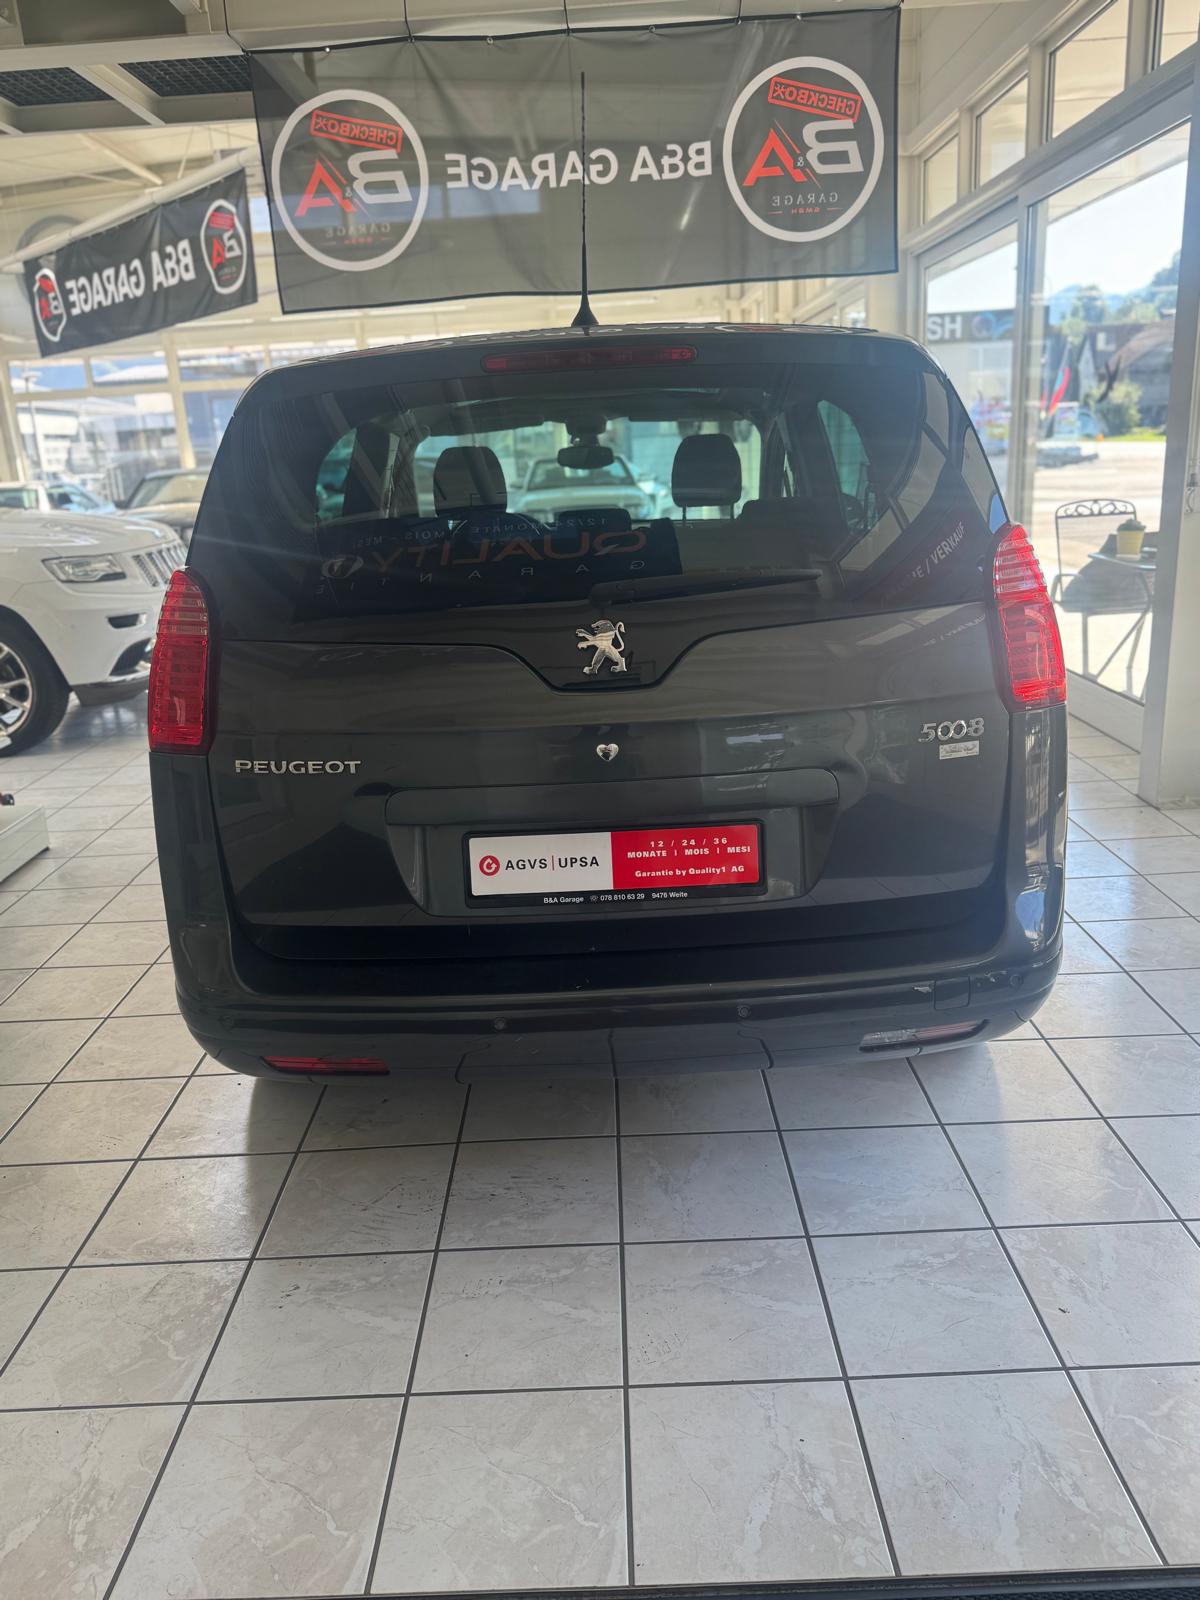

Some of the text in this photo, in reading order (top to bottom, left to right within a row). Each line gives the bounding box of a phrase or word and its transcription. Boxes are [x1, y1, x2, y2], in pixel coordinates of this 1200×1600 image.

[918, 717, 985, 742] 5008
[235, 759, 361, 775] PEUGEOT
[650, 840, 664, 848] 12
[682, 838, 696, 846] 24
[713, 837, 727, 845] 36
[627, 850, 667, 858] MONATE
[685, 847, 709, 856] MOIS
[727, 846, 751, 854] MESI
[505, 856, 599, 871] AGVS UPSA
[635, 865, 744, 878] Garantie by Quality1 AG
[560, 896, 584, 904] Garage
